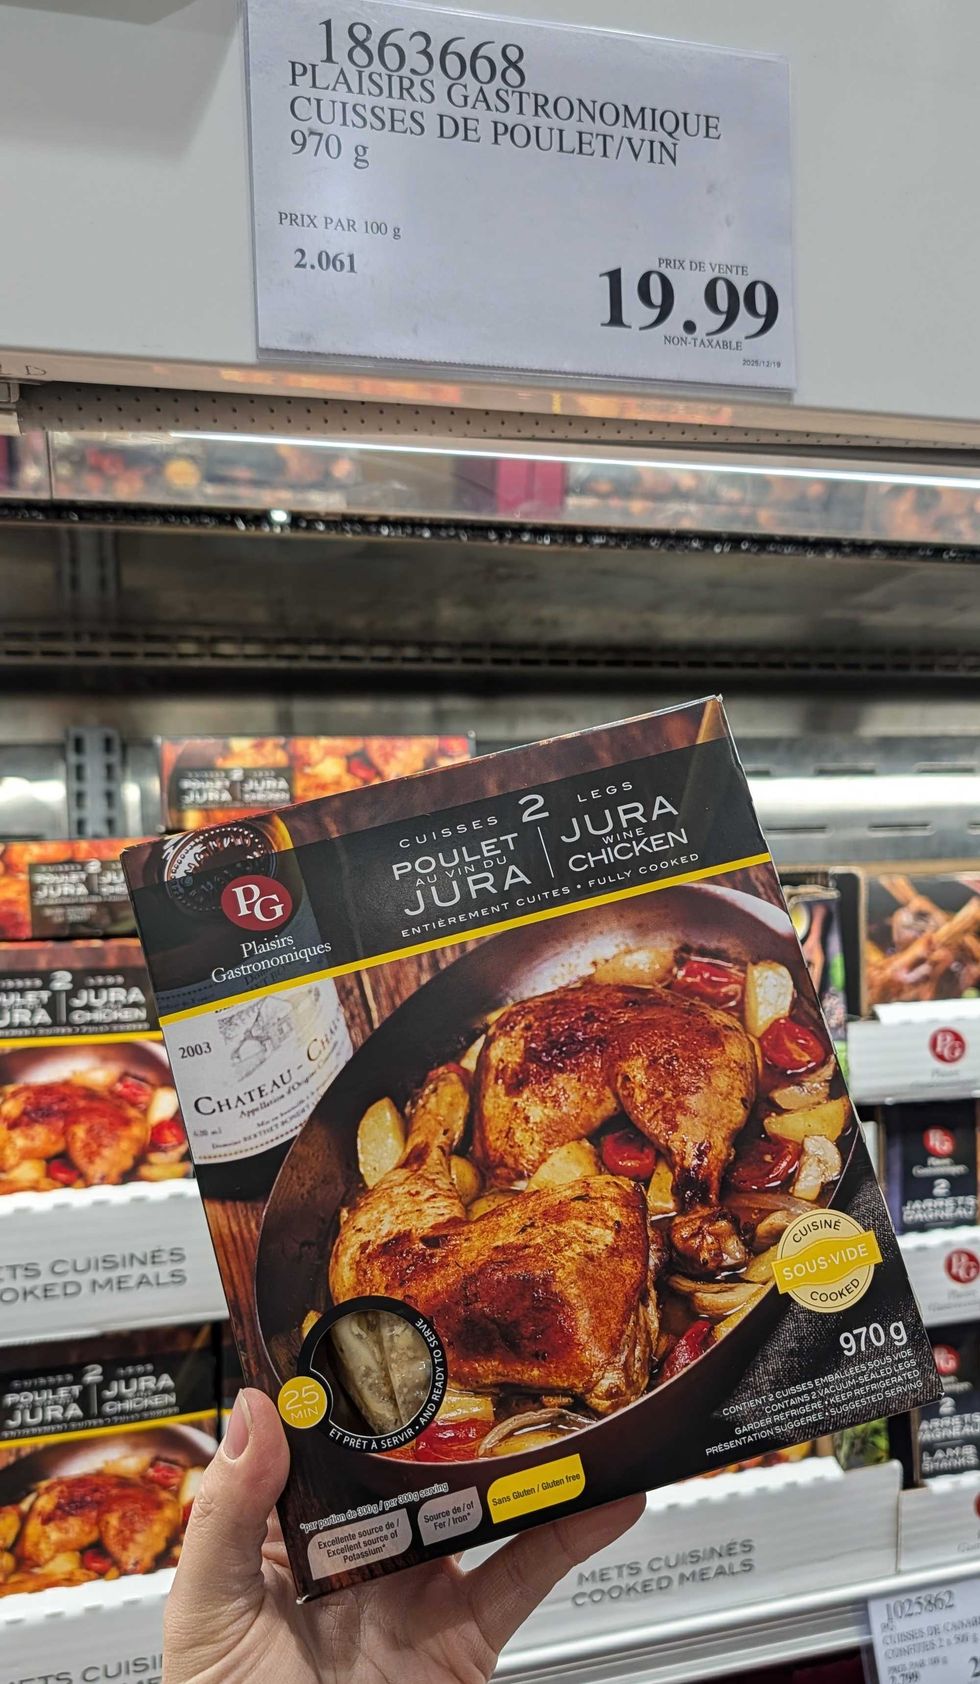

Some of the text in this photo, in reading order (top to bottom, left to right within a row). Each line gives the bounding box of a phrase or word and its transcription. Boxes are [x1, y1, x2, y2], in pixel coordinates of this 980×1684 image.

[318, 17, 526, 89] 1863668
[289, 60, 722, 140] PLAISIRS GASTRONOMIQUE
[289, 96, 679, 166] CUISSES DE POULET/VIN
[290, 129, 370, 169] 970 g
[278, 210, 401, 240] PRIX PAR 100 g
[294, 248, 358, 274] 2.061
[657, 257, 749, 277] PRIX DE VENTE
[599, 267, 779, 341] 19.99
[663, 335, 743, 352] NON-TAXABLE
[399, 781, 633, 848] CUISSES 2 LEGS
[560, 795, 679, 843] JURA
[568, 828, 688, 872] CHICKEN
[602, 827, 646, 844] WINE
[392, 833, 518, 880] POULET
[416, 856, 507, 887] AU VIN DU
[232, 884, 284, 922] PG
[401, 853, 699, 937] ENTIÈREMENT CUITES FULLY COOKED
[404, 865, 532, 916] JURA
[212, 942, 332, 983] Gastronomiques
[240, 935, 294, 958] Plaisirs
[50, 970, 73, 991] 2
[68, 986, 146, 1008] JURA
[178, 1041, 212, 1059] 2003
[194, 1069, 292, 1116] CHATEAU
[792, 1219, 842, 1243] CUISINÉ
[0, 1246, 187, 1282] TS CUISINÉS
[91, 1269, 187, 1295] MEALS
[810, 1278, 860, 1302] COOKED
[839, 1320, 908, 1357] 970 g
[2, 1384, 83, 1408] POULET
[101, 1373, 176, 1400] JURA
[82, 1364, 104, 1385] 2
[329, 1318, 445, 1450] ET PRÊT À SERVIR AND READY TO SERVE
[722, 1395, 769, 1416] CONTIENT
[769, 1393, 775, 1401] 2
[775, 1381, 814, 1399] CUISSES
[867, 1355, 892, 1369] SOUS
[892, 1349, 914, 1361] VIDE
[764, 1359, 917, 1414] CONTAINS 2 VACUUM-SEALED LEGS
[3, 1403, 84, 1429] JURA
[101, 1392, 177, 1416] CHICKEN
[283, 1385, 320, 1411] 25
[290, 1406, 319, 1421] MIN
[734, 1416, 773, 1435] GARDER
[829, 1390, 853, 1405] KEEP
[853, 1369, 921, 1397] REFRIGERATED
[830, 1393, 883, 1416] SUGGESTED
[884, 1379, 923, 1398] SERVING
[939, 1397, 956, 1416] 2
[318, 1513, 345, 1528] portion
[346, 1509, 357, 1520] de
[384, 1498, 398, 1510] per
[419, 1482, 449, 1498] serving
[492, 1495, 511, 1506] Sans
[512, 1486, 536, 1500] Gluten
[542, 1478, 564, 1491] Gluten
[565, 1473, 581, 1483] free
[423, 1509, 451, 1524] Source
[434, 1520, 448, 1532] Fer
[318, 1531, 356, 1550] Excellente
[358, 1525, 383, 1537] source
[382, 1521, 395, 1530] de
[326, 1530, 398, 1558] Excellent source of
[577, 1539, 755, 1586] METS CUISINÉS
[571, 1558, 755, 1607] COOKED MEALS
[81, 1654, 162, 1683] CUISI
